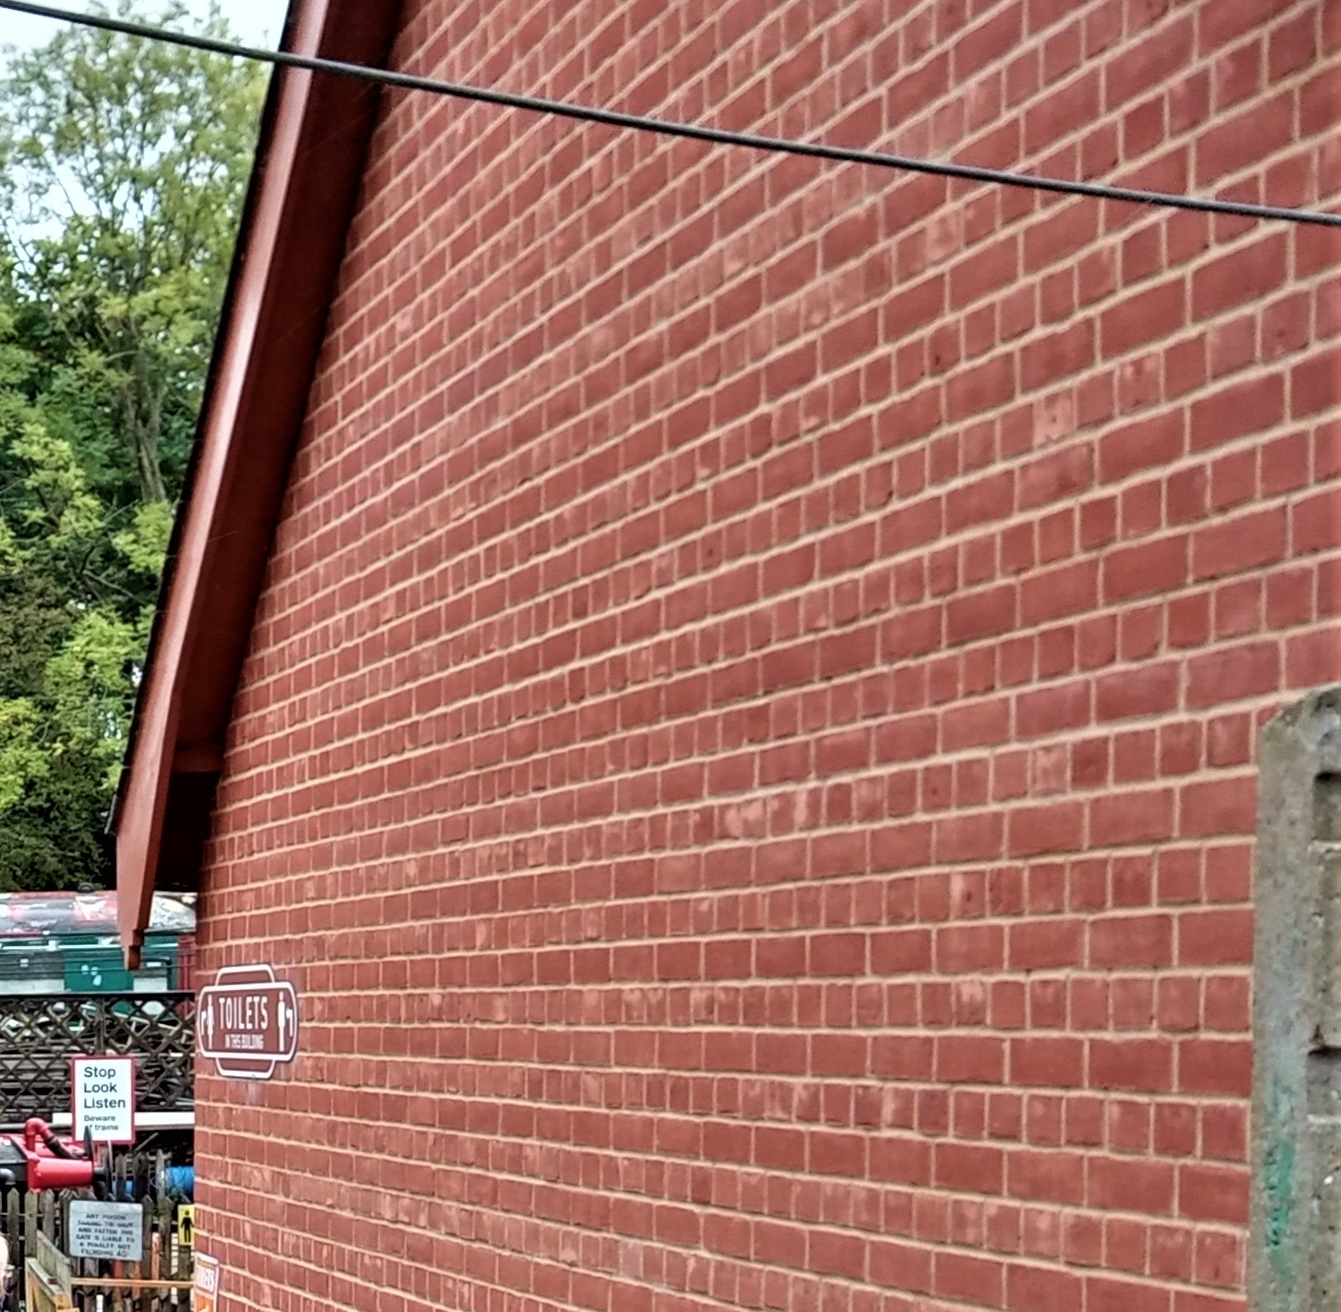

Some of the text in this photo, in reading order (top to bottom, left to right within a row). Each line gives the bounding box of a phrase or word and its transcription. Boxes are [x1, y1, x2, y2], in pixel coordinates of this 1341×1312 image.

[218, 995, 269, 1031] TOILETS
[83, 1066, 116, 1079] Stop
[83, 1082, 118, 1094] Look
[83, 1098, 126, 1109] Listen
[83, 1114, 116, 1122] Beware
